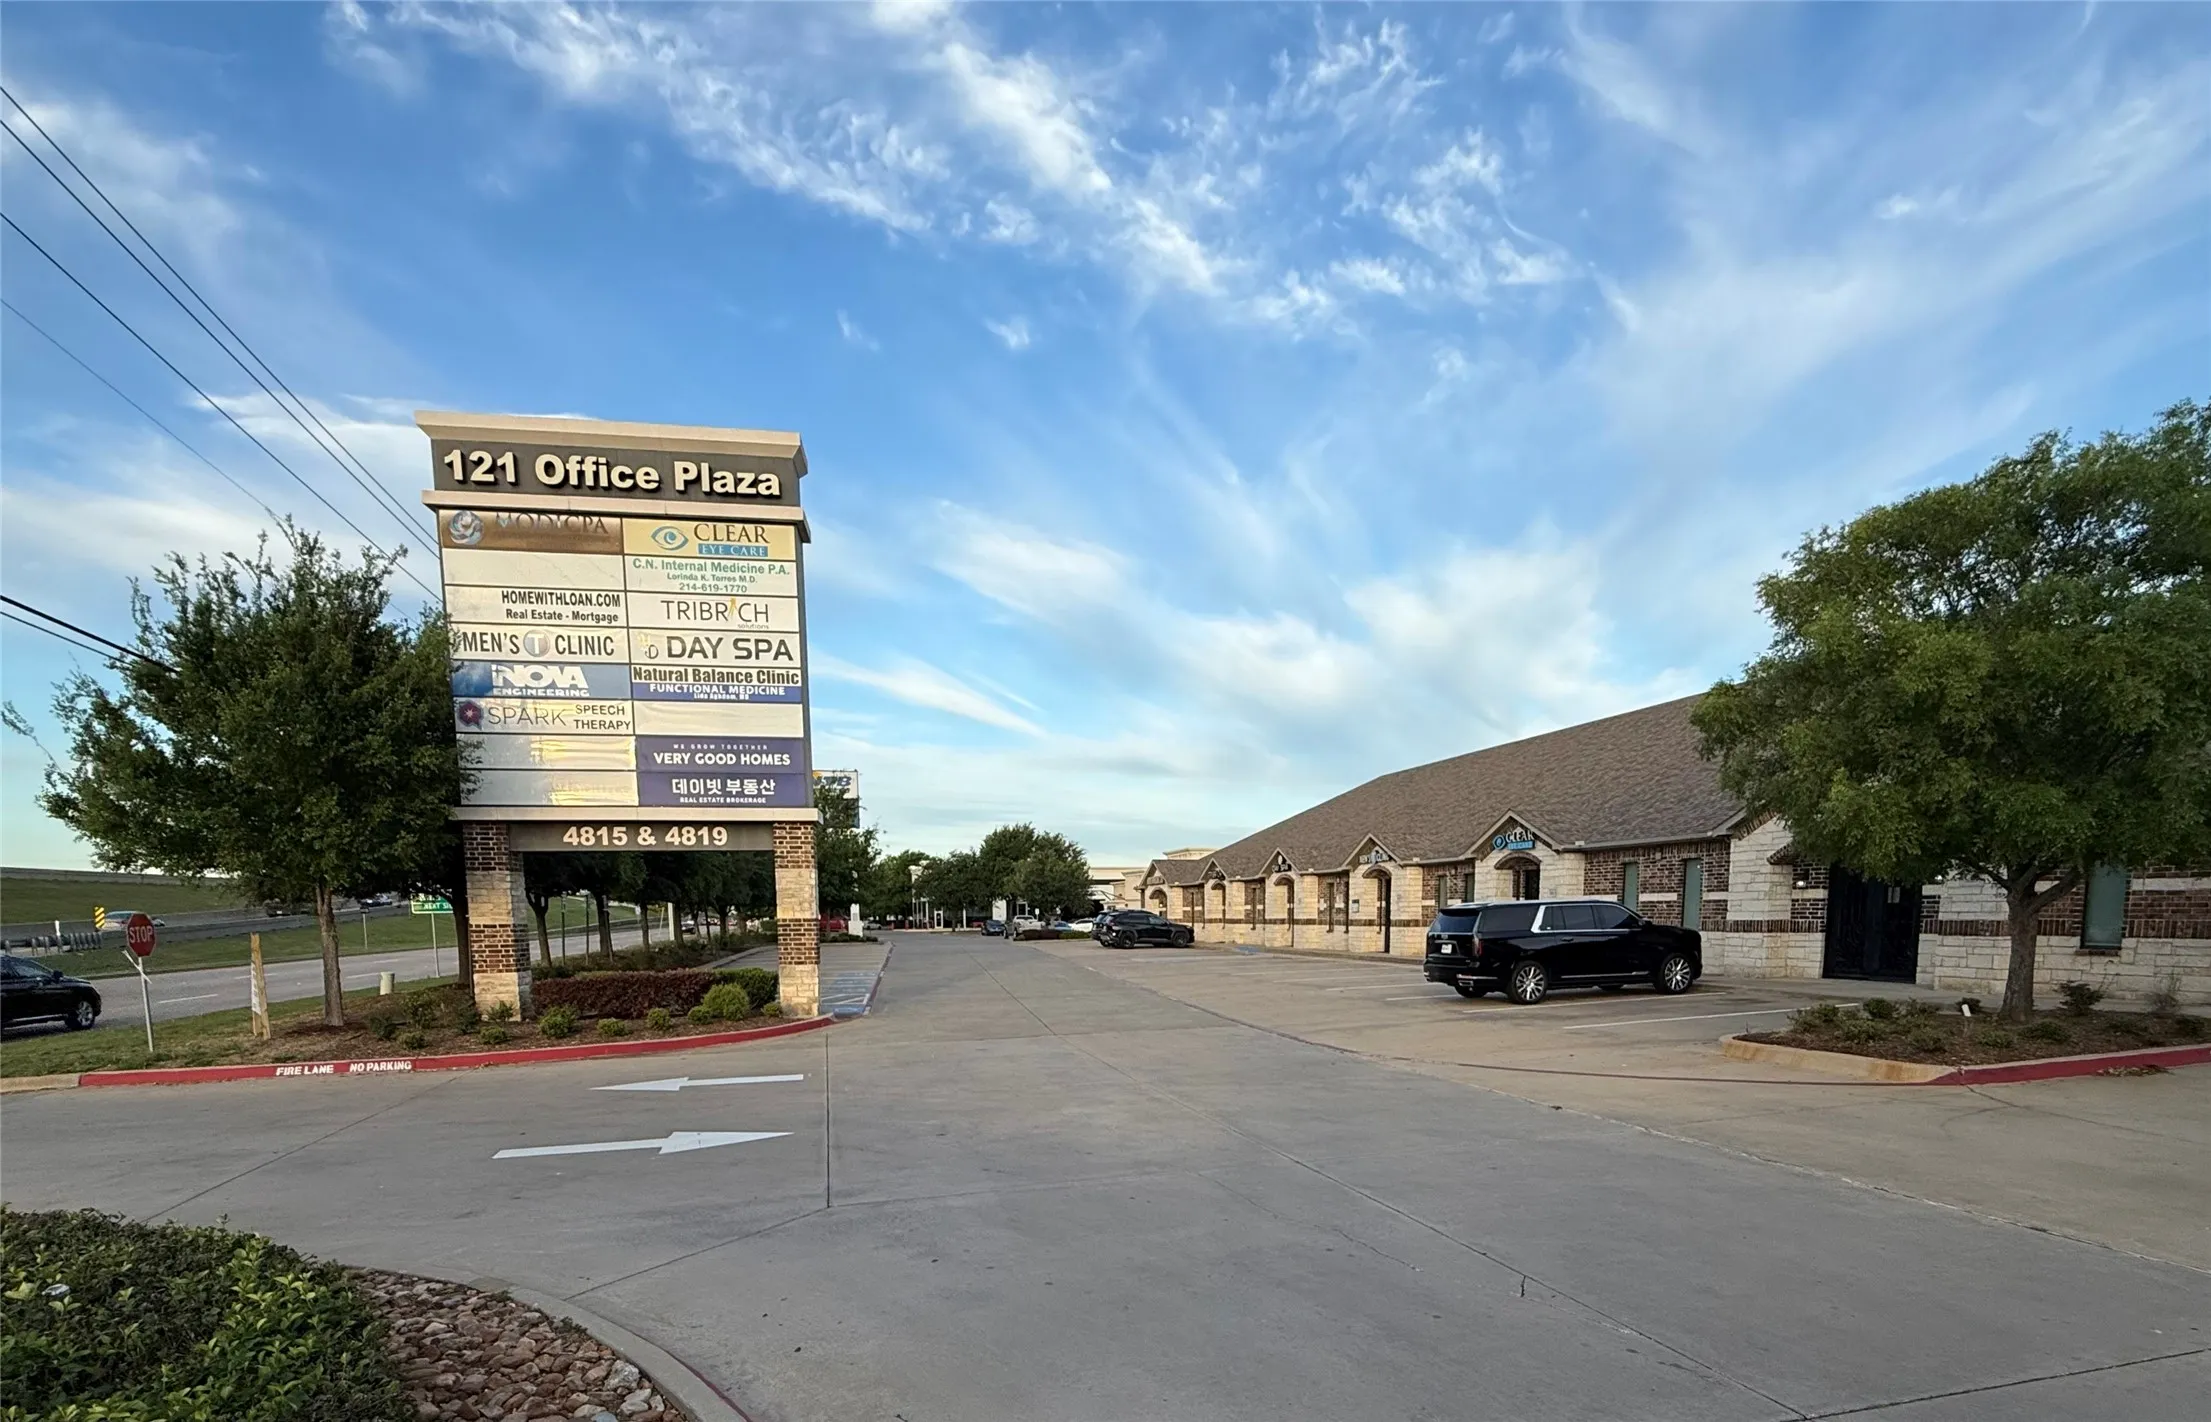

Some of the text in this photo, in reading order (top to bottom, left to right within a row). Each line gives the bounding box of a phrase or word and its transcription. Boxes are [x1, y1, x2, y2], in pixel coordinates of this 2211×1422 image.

[444, 449, 781, 496] 121 Office Plaza
[694, 523, 770, 544] CLEAR
[701, 544, 766, 557] EYE CARE
[632, 557, 791, 576] C.N. Internal Medicine P.A.
[666, 573, 699, 582] Lorinda
[679, 582, 748, 594] 214-619-1770
[501, 590, 621, 608] HOMEWITHLOAN.COM
[506, 608, 528, 620] Real
[531, 609, 563, 621] Estate
[571, 611, 619, 625] Mortgage
[737, 622, 770, 630] solutions
[554, 634, 615, 657] CLINIC
[666, 636, 794, 662] DAY SPA
[633, 667, 800, 685] Natural Balance Clinic
[492, 687, 590, 698] ENGINEERING
[649, 683, 786, 695] FUNCTIONAL MEDICINE
[488, 706, 567, 727] SPARK
[575, 704, 626, 717] SPEECH
[574, 719, 632, 732] THERAPY
[653, 752, 791, 767] VERY GOOD HOMES
[672, 777, 776, 796] 데이빗 부동산
[679, 796, 698, 804] REAL
[699, 796, 725, 804] ESTATE
[562, 826, 729, 847] 4815 & 4819
[129, 925, 154, 944] STOP
[275, 1060, 413, 1076] FIRE LANE NO PARKING
